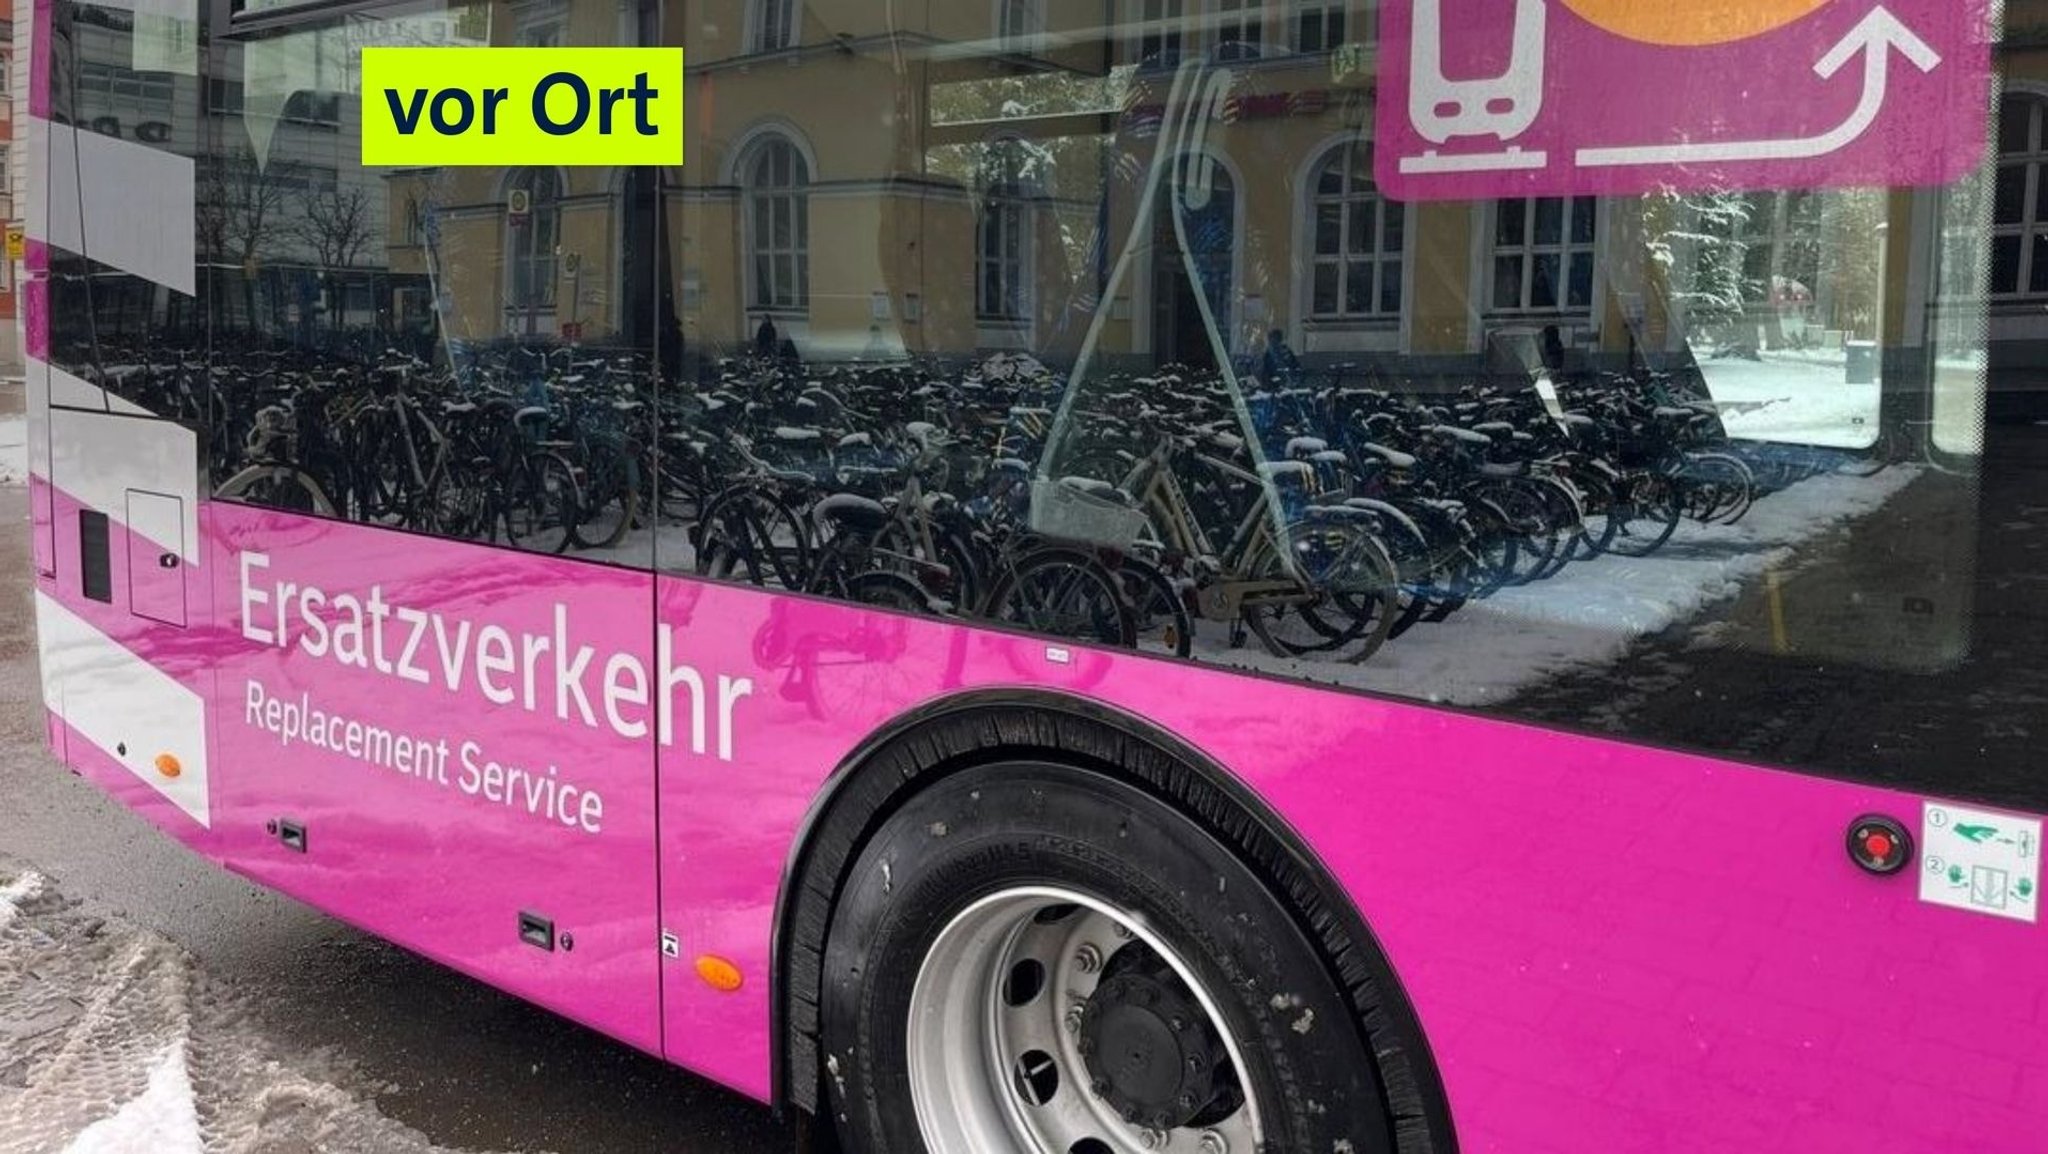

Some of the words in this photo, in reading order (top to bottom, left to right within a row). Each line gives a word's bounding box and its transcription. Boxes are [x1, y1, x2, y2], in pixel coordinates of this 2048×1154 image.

[240, 549, 754, 763] Ersatzverkehr
[245, 678, 451, 787] Replacement
[458, 740, 604, 834] Service
